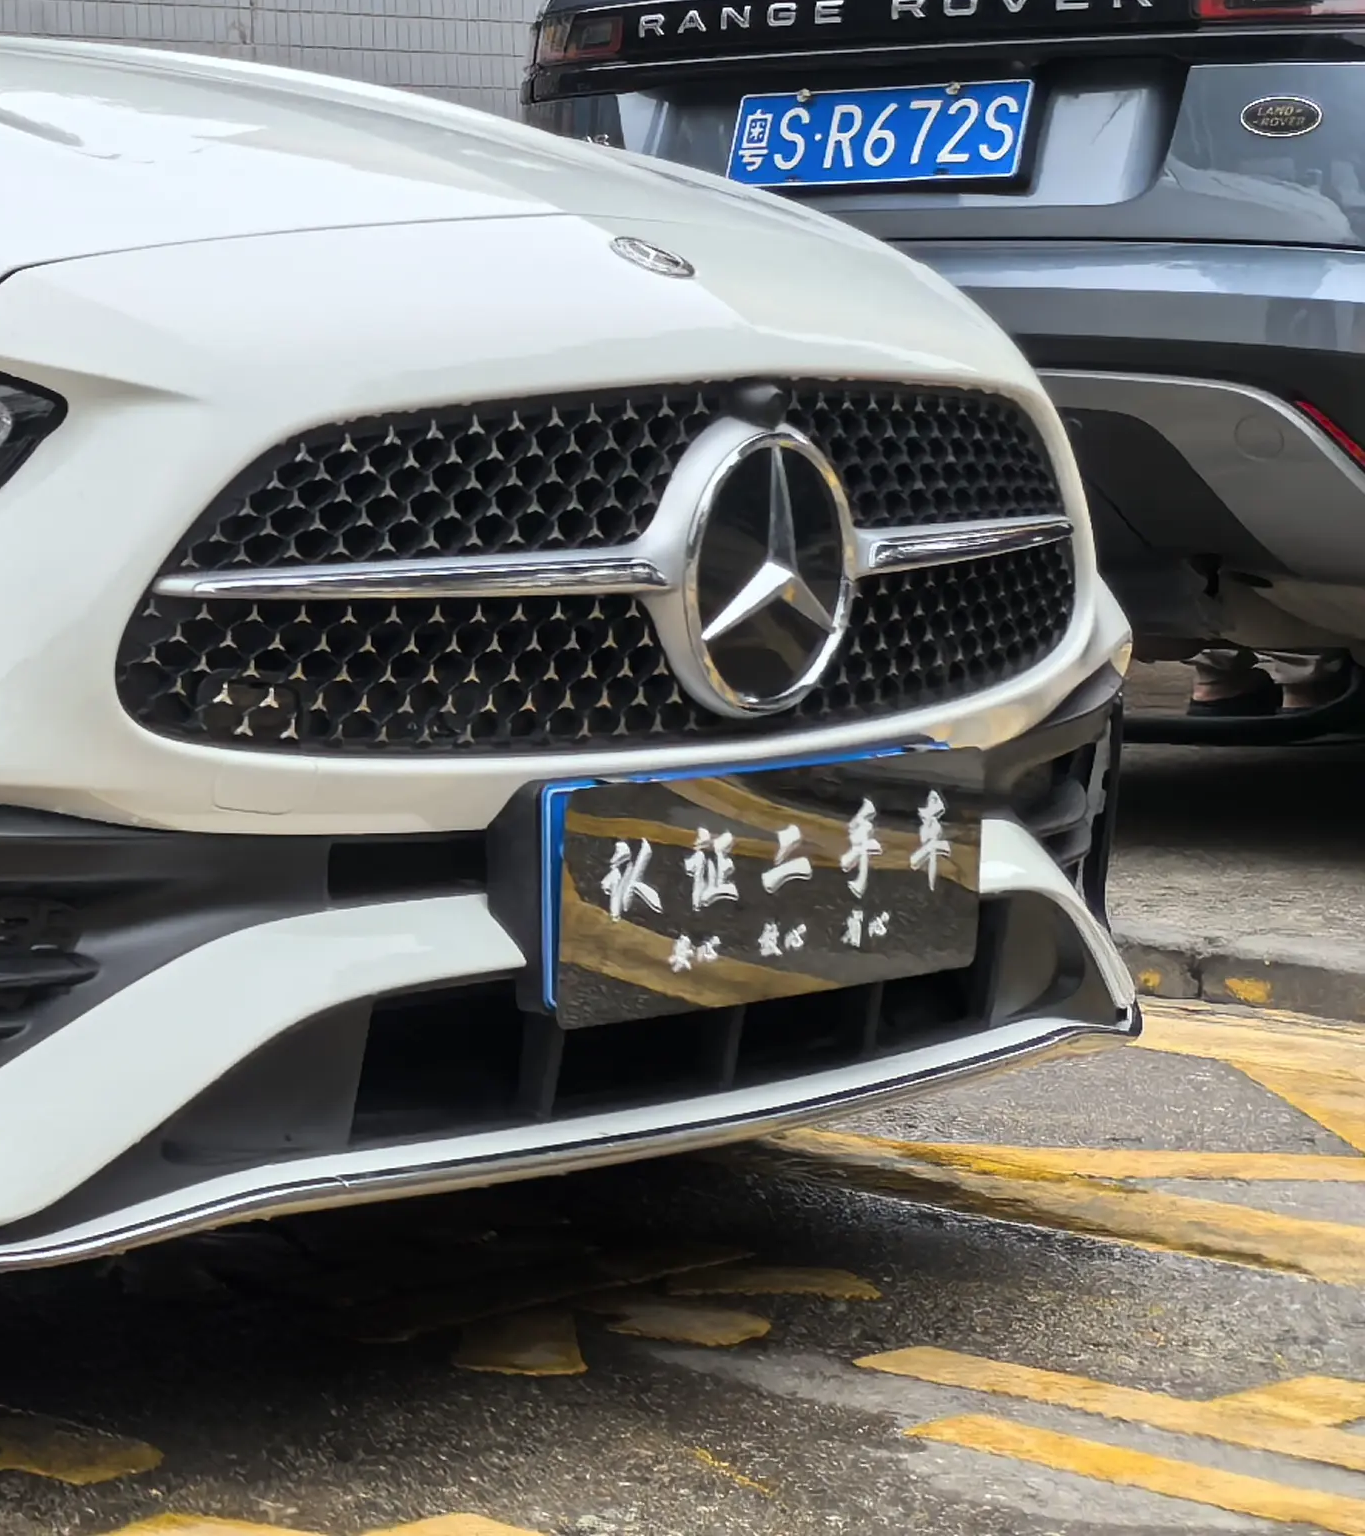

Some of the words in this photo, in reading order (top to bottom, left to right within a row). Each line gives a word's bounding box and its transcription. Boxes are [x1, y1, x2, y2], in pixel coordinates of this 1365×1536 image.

[638, 0, 845, 38] RANGE
[738, 95, 1019, 171] 粤S·R672S
[601, 789, 952, 922] 认证二手车
